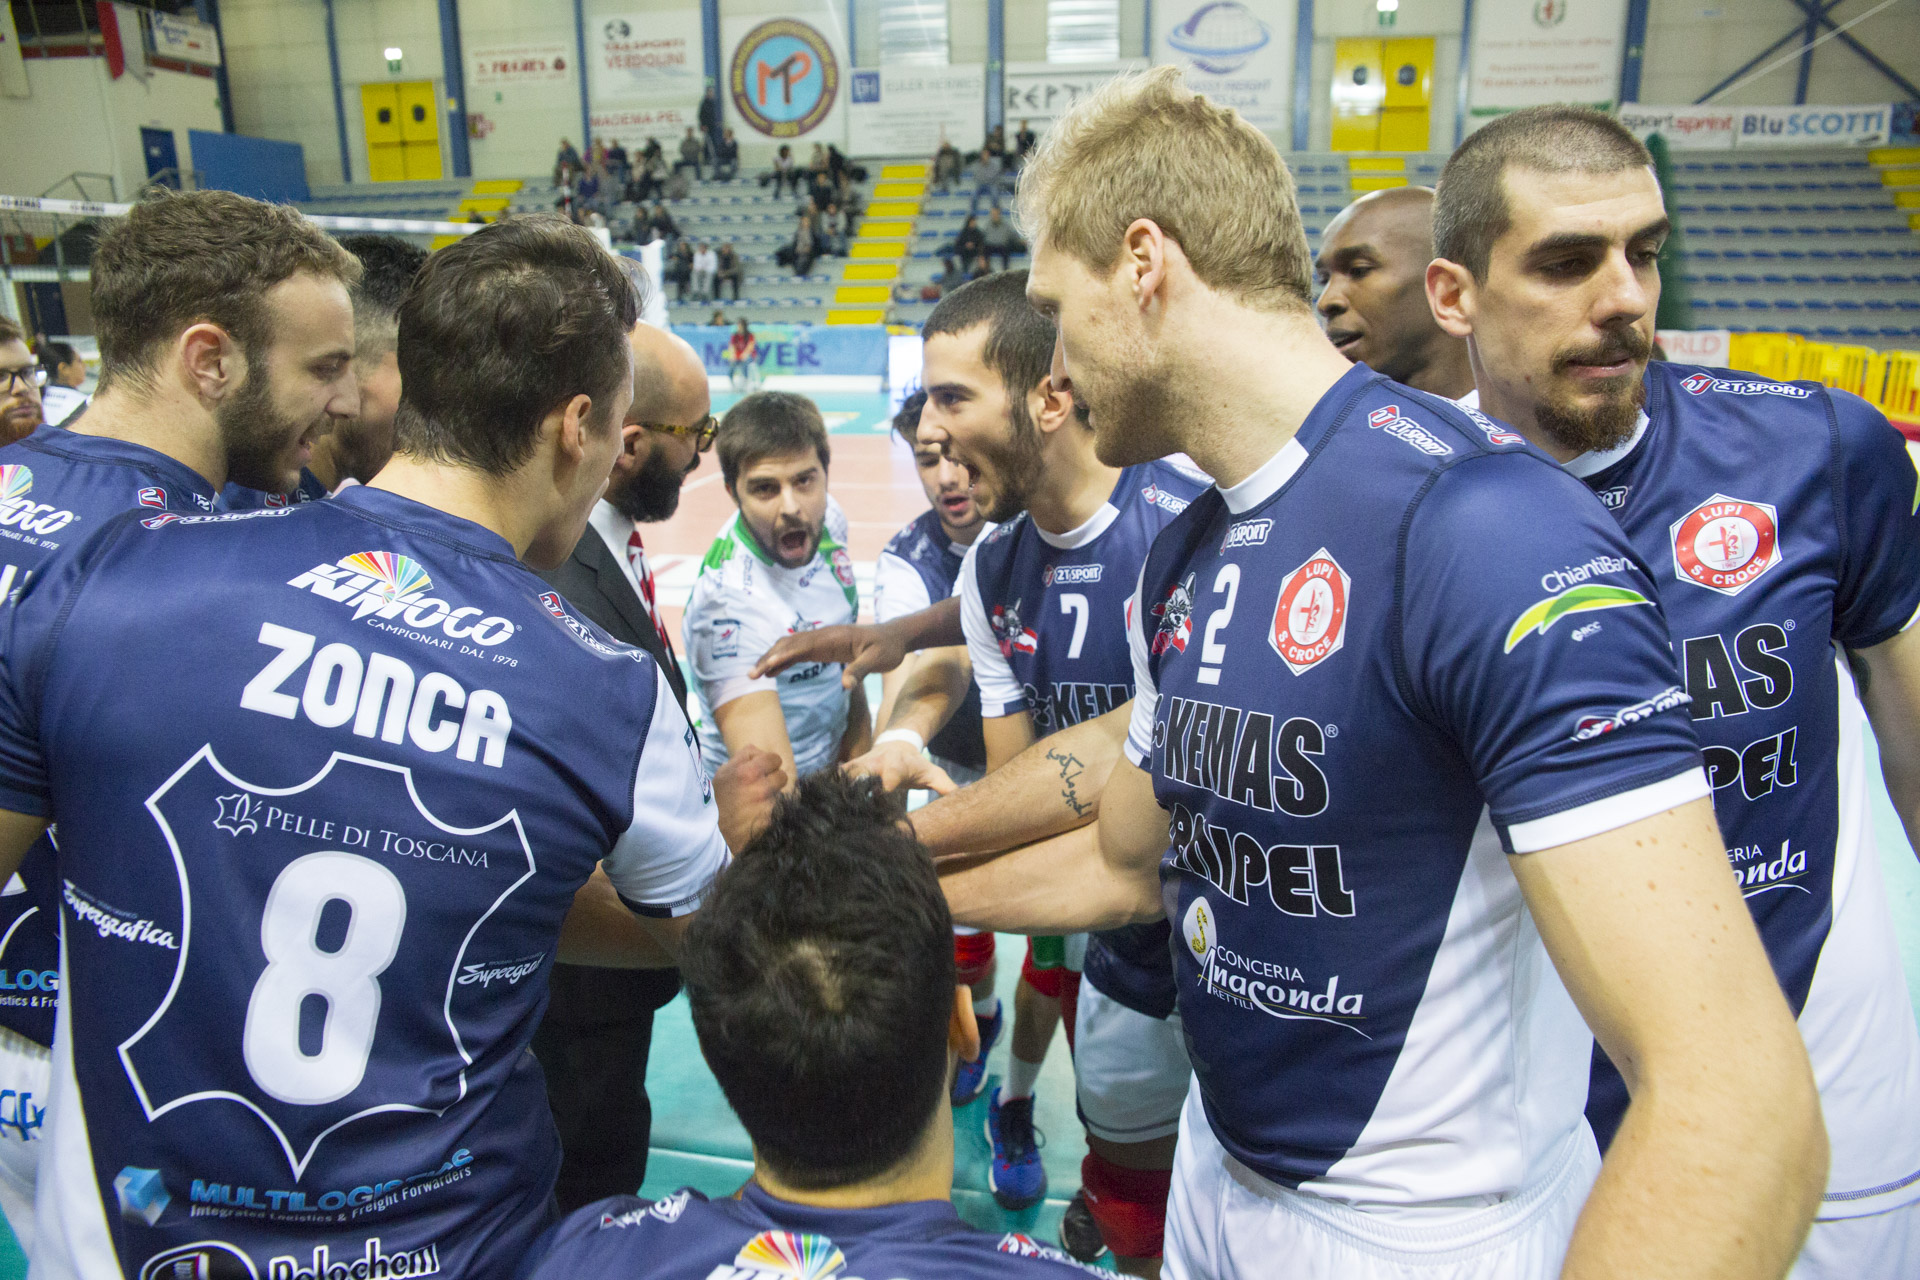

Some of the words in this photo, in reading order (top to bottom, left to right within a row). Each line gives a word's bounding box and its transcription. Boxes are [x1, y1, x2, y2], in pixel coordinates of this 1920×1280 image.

[0, 496, 74, 535] OCO
[1698, 504, 1742, 522] LUPI
[1305, 562, 1334, 579] LUPI
[1541, 556, 1638, 592] ChiantiBan
[1690, 564, 1705, 580] S.
[1712, 556, 1766, 585] CROCE
[1060, 593, 1089, 659] 7
[1201, 563, 1241, 664] 2
[367, 618, 454, 650] CAMPIONARI
[460, 645, 485, 659] DAL
[492, 654, 518, 668] 1978
[1278, 630, 1289, 648] S.
[1288, 635, 1332, 661] CROCE
[240, 622, 513, 768] ZONCA
[1051, 681, 1136, 730] KEM
[1163, 696, 1329, 817] KEMAS
[264, 806, 336, 841] PELLE
[342, 825, 370, 848] DI
[379, 829, 489, 868] TOSCANA
[1726, 844, 1764, 863] ERIA
[1733, 838, 1808, 886] onda
[63, 878, 180, 950] Supergrafica
[242, 849, 407, 1106] 8
[457, 951, 547, 988] Supergra
[1197, 947, 1364, 1020] Anaconda
[1216, 945, 1306, 984] CONCERIA
[30, 996, 39, 1007] &
[1212, 986, 1254, 1011] RETTILI
[190, 1204, 266, 1220] Integrated
[269, 1211, 333, 1223] Logistics
[336, 1212, 347, 1223] &
[351, 1192, 400, 1219] Freight
[401, 1166, 472, 1201] Forwarders
